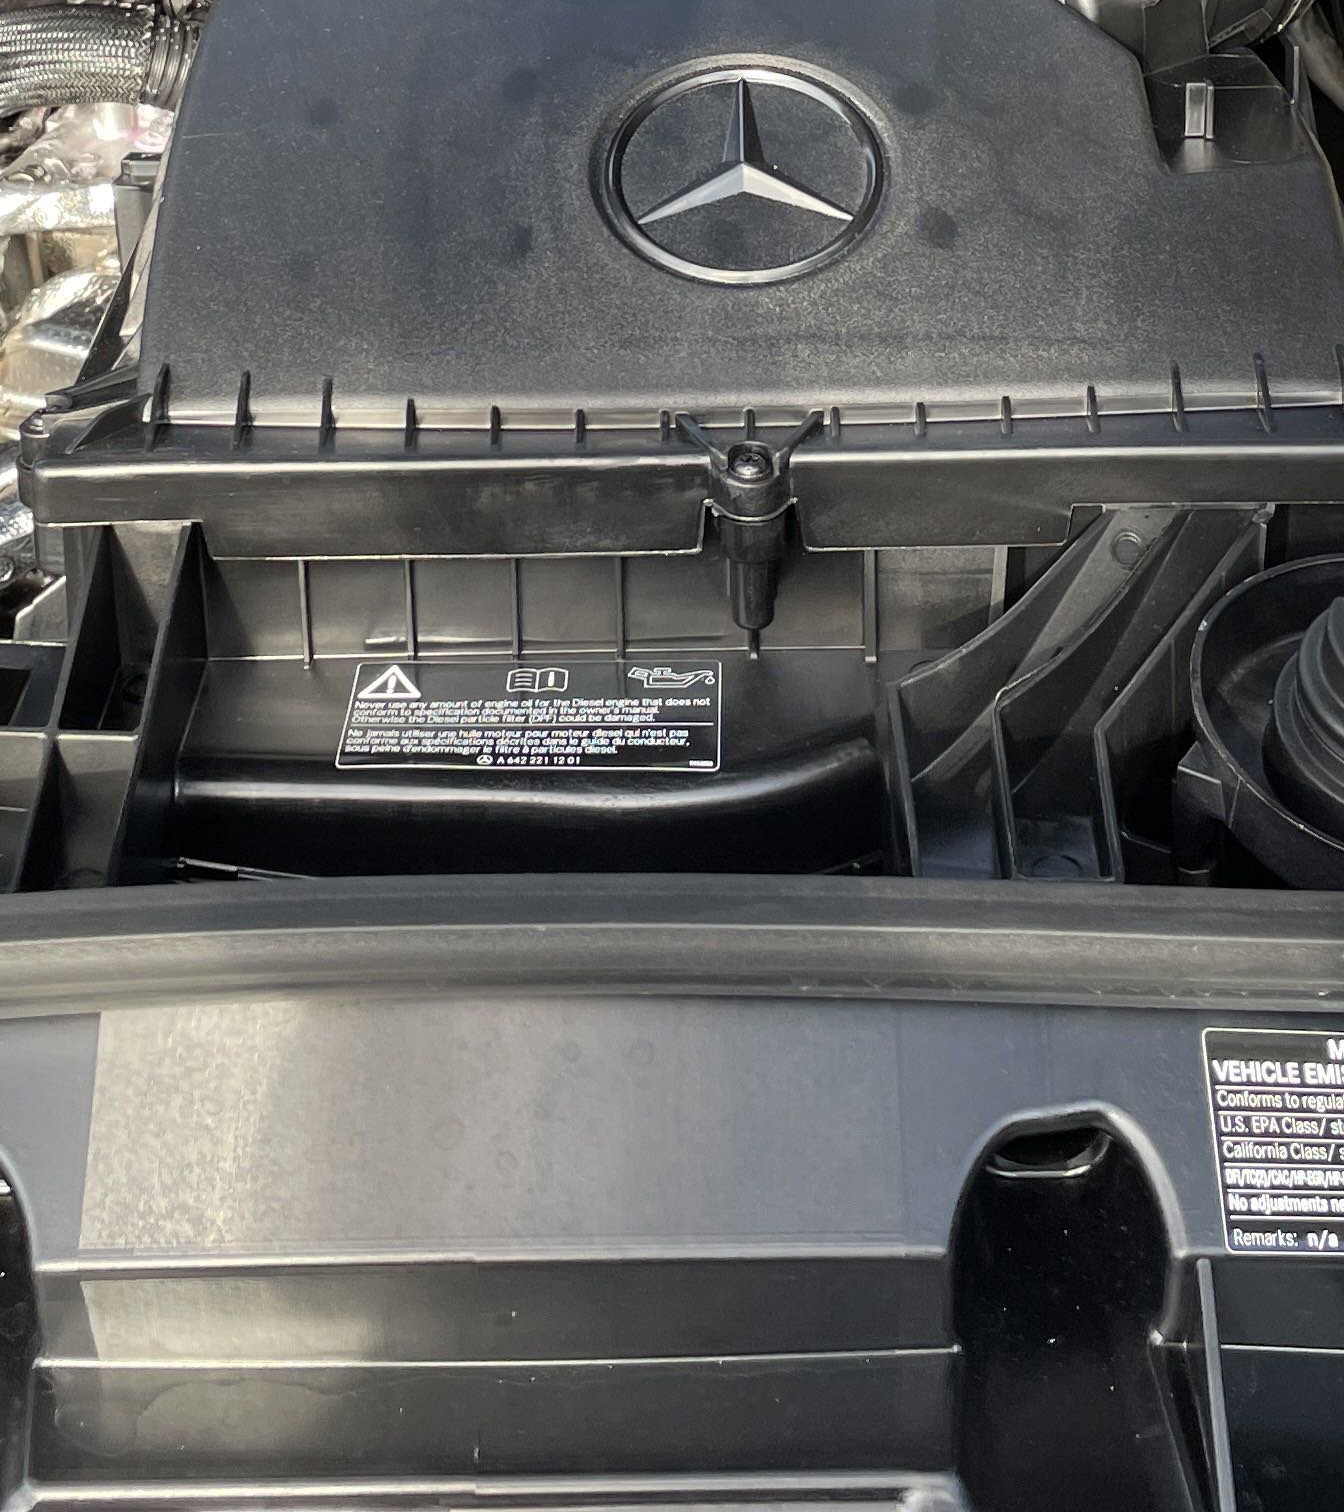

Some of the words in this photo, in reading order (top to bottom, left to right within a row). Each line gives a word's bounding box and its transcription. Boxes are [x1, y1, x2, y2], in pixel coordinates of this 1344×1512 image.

[506, 756, 527, 764] 642
[529, 756, 548, 764] 221
[1211, 1058, 1301, 1084] VEHICLE
[1216, 1089, 1282, 1108] Conforms
[1284, 1091, 1300, 1109] to
[1218, 1113, 1249, 1132] U.S.
[1249, 1115, 1281, 1134] EPA
[1222, 1140, 1287, 1159] California
[1228, 1192, 1248, 1211] No
[1249, 1193, 1329, 1215] adjustments
[1233, 1228, 1298, 1247] Remarks:
[1306, 1229, 1338, 1249] n/a
